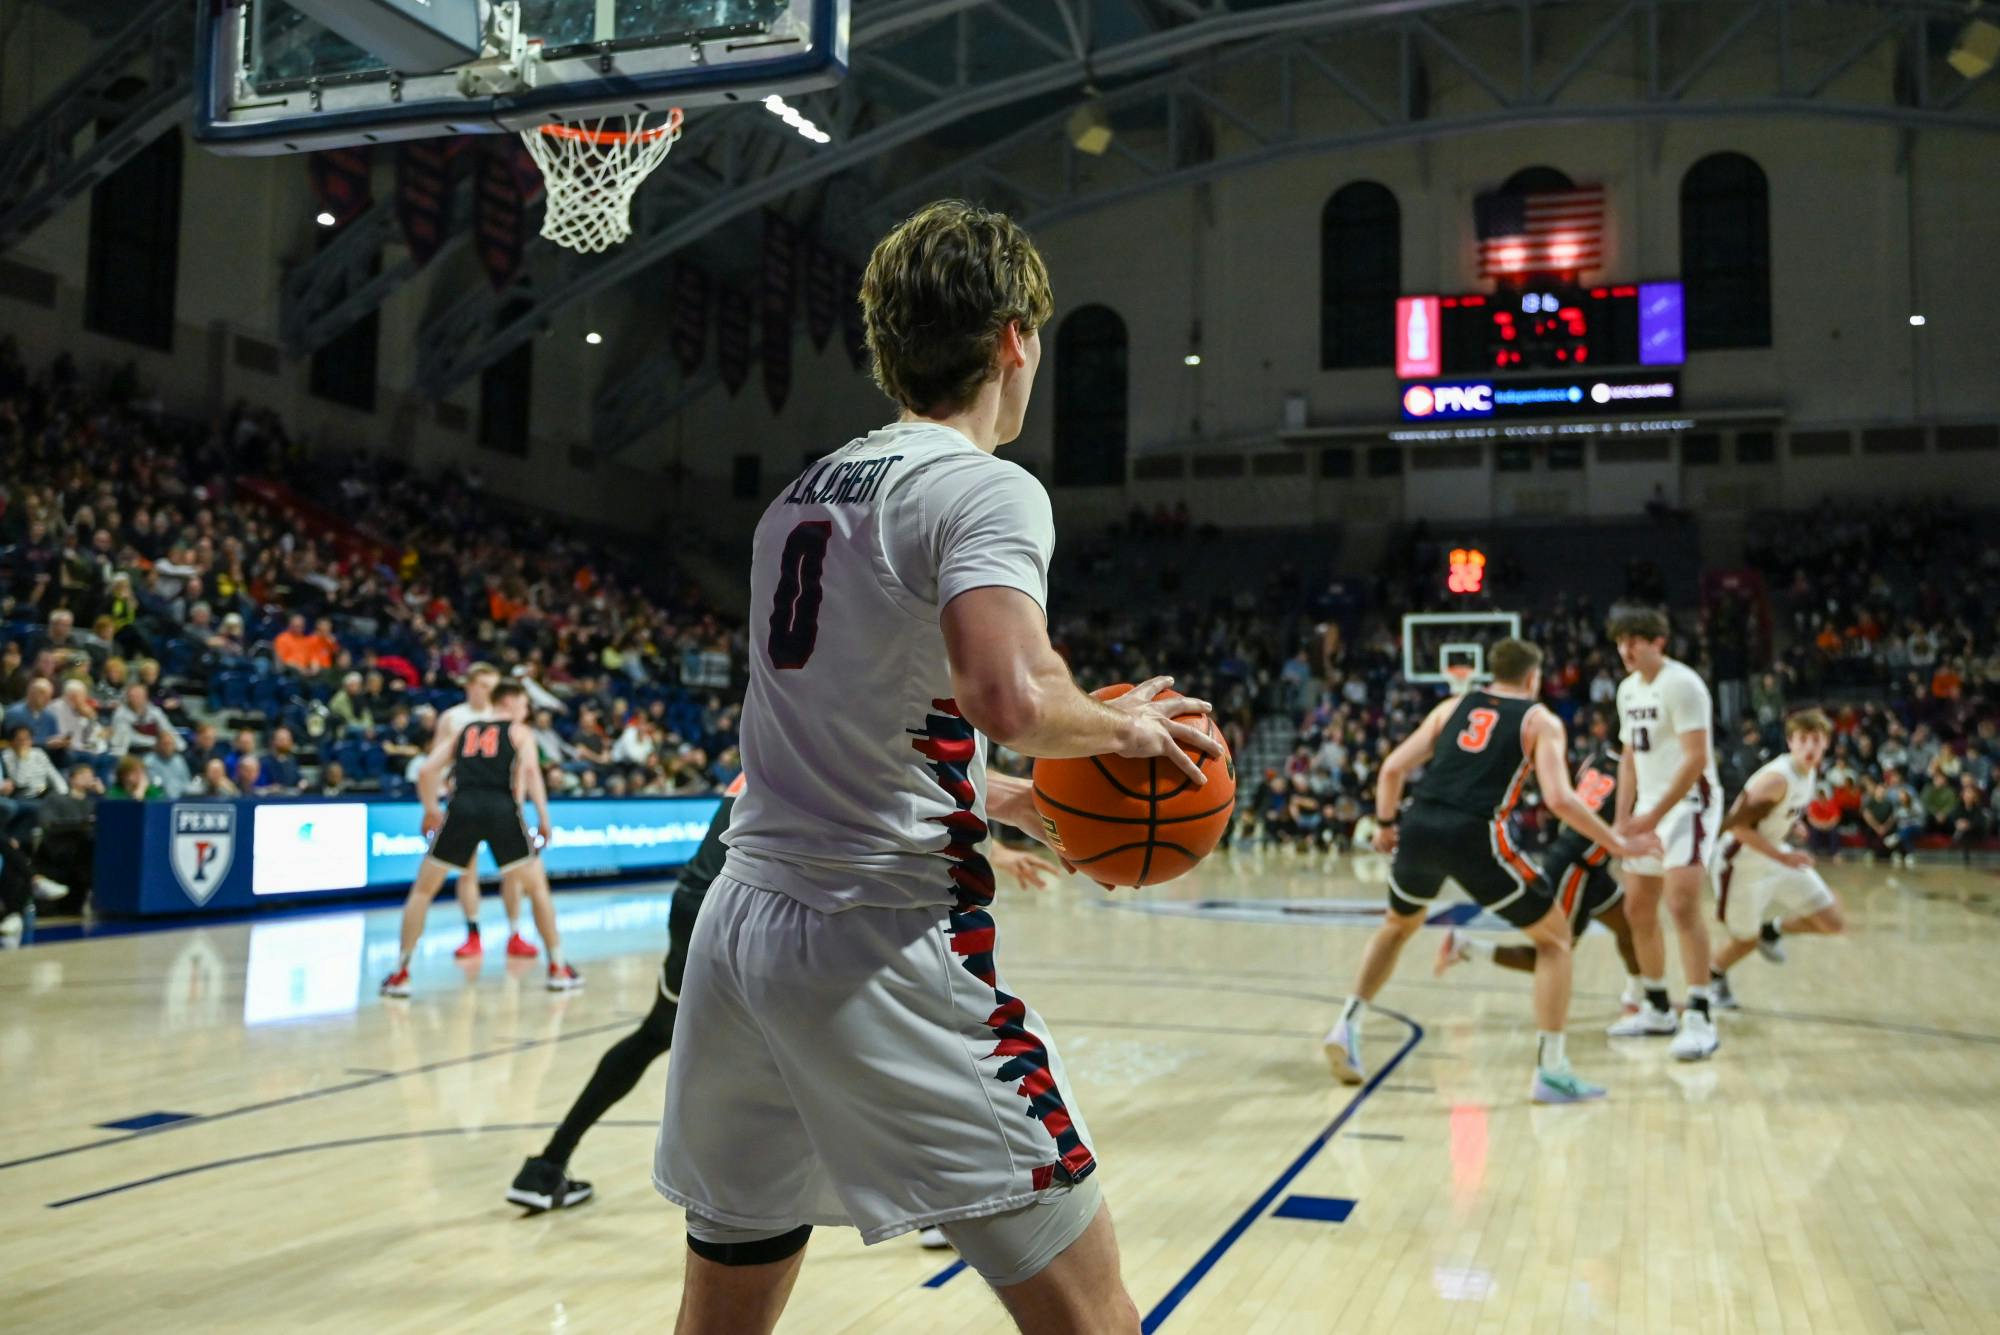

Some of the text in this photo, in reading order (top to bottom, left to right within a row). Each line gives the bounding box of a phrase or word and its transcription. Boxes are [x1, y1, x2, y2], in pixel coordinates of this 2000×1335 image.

[1434, 385, 1492, 413] PNC
[768, 520, 832, 670] 0
[462, 725, 500, 758] 14
[1457, 707, 1500, 754] 3
[178, 811, 230, 832] PENN
[194, 842, 217, 881] P
